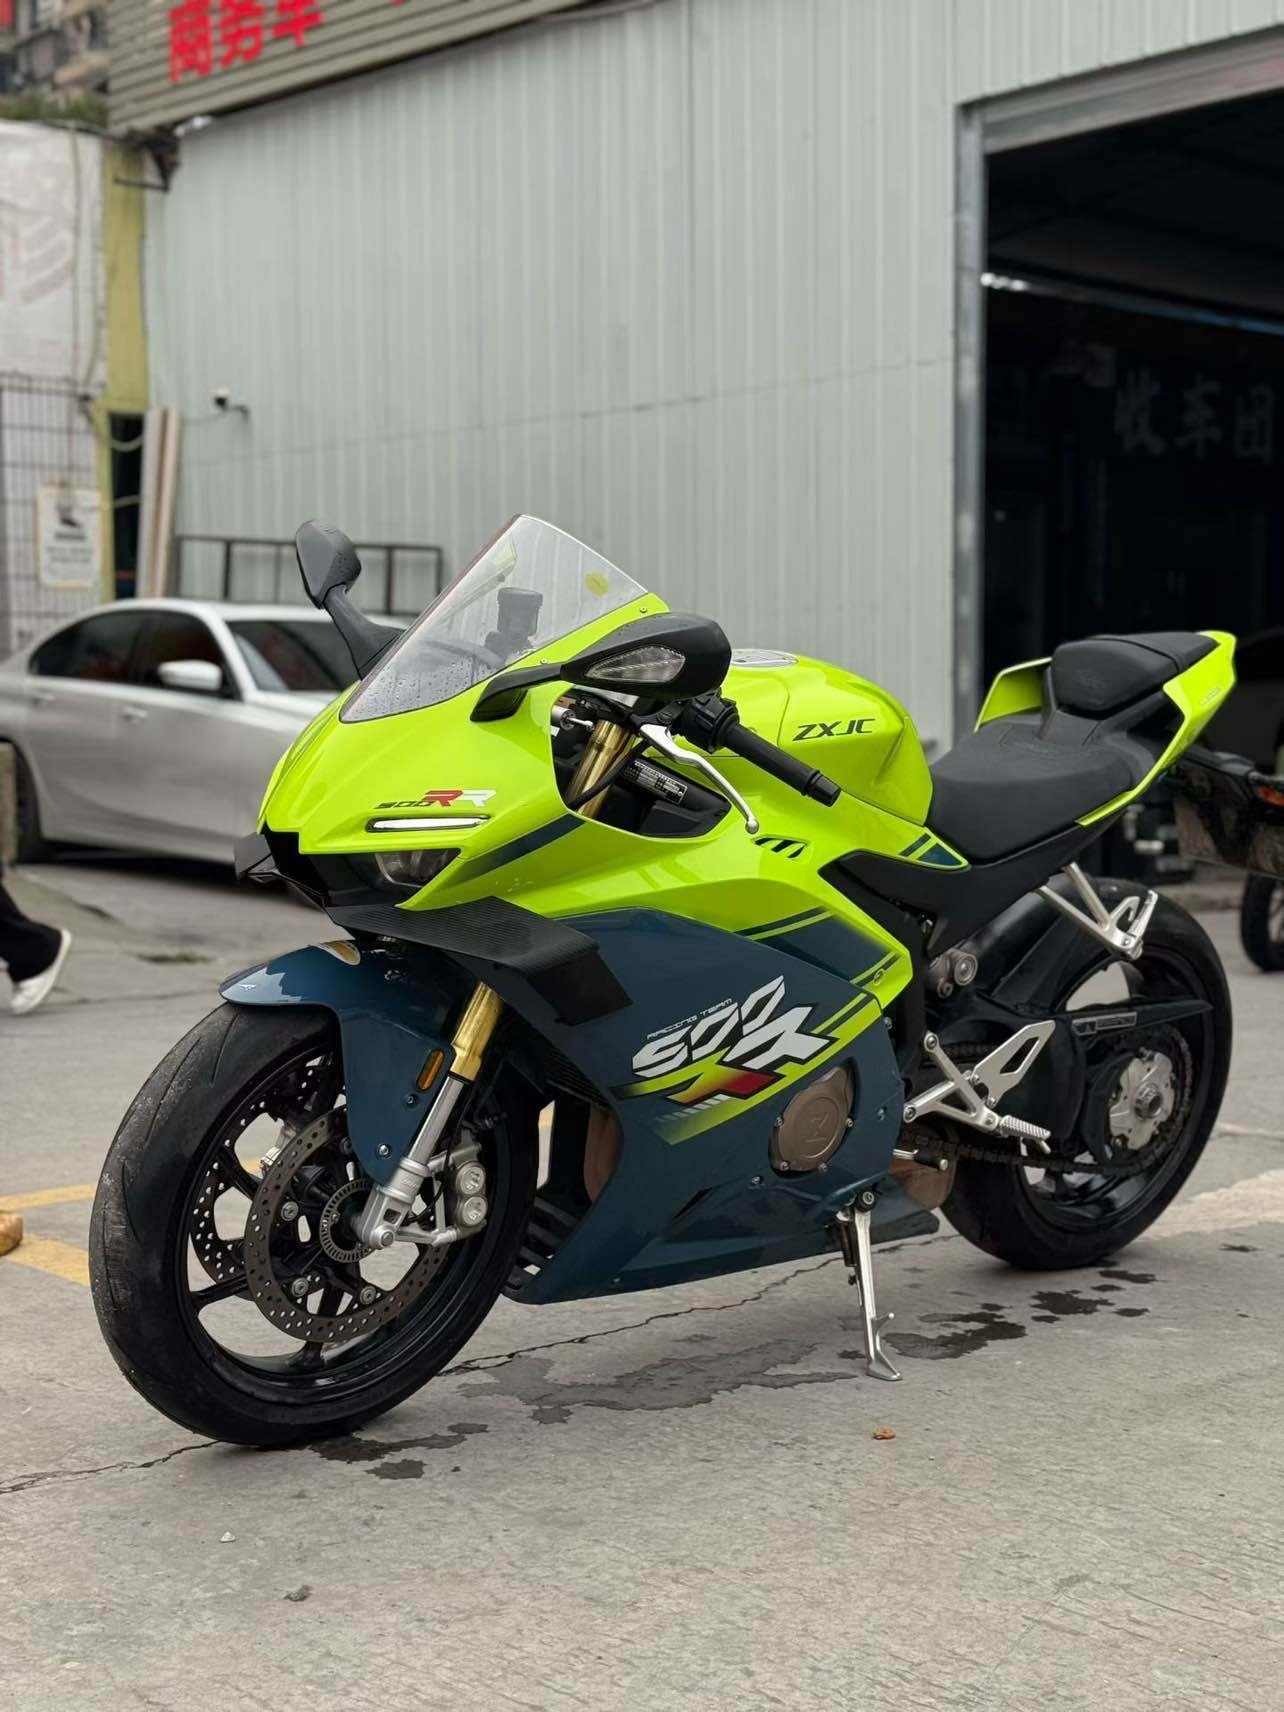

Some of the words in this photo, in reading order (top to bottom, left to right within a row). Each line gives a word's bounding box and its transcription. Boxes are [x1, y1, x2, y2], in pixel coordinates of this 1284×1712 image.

[169, 0, 325, 86] 商务车
[647, 1014, 698, 1040] RACING
[699, 998, 732, 1016] TEAM
